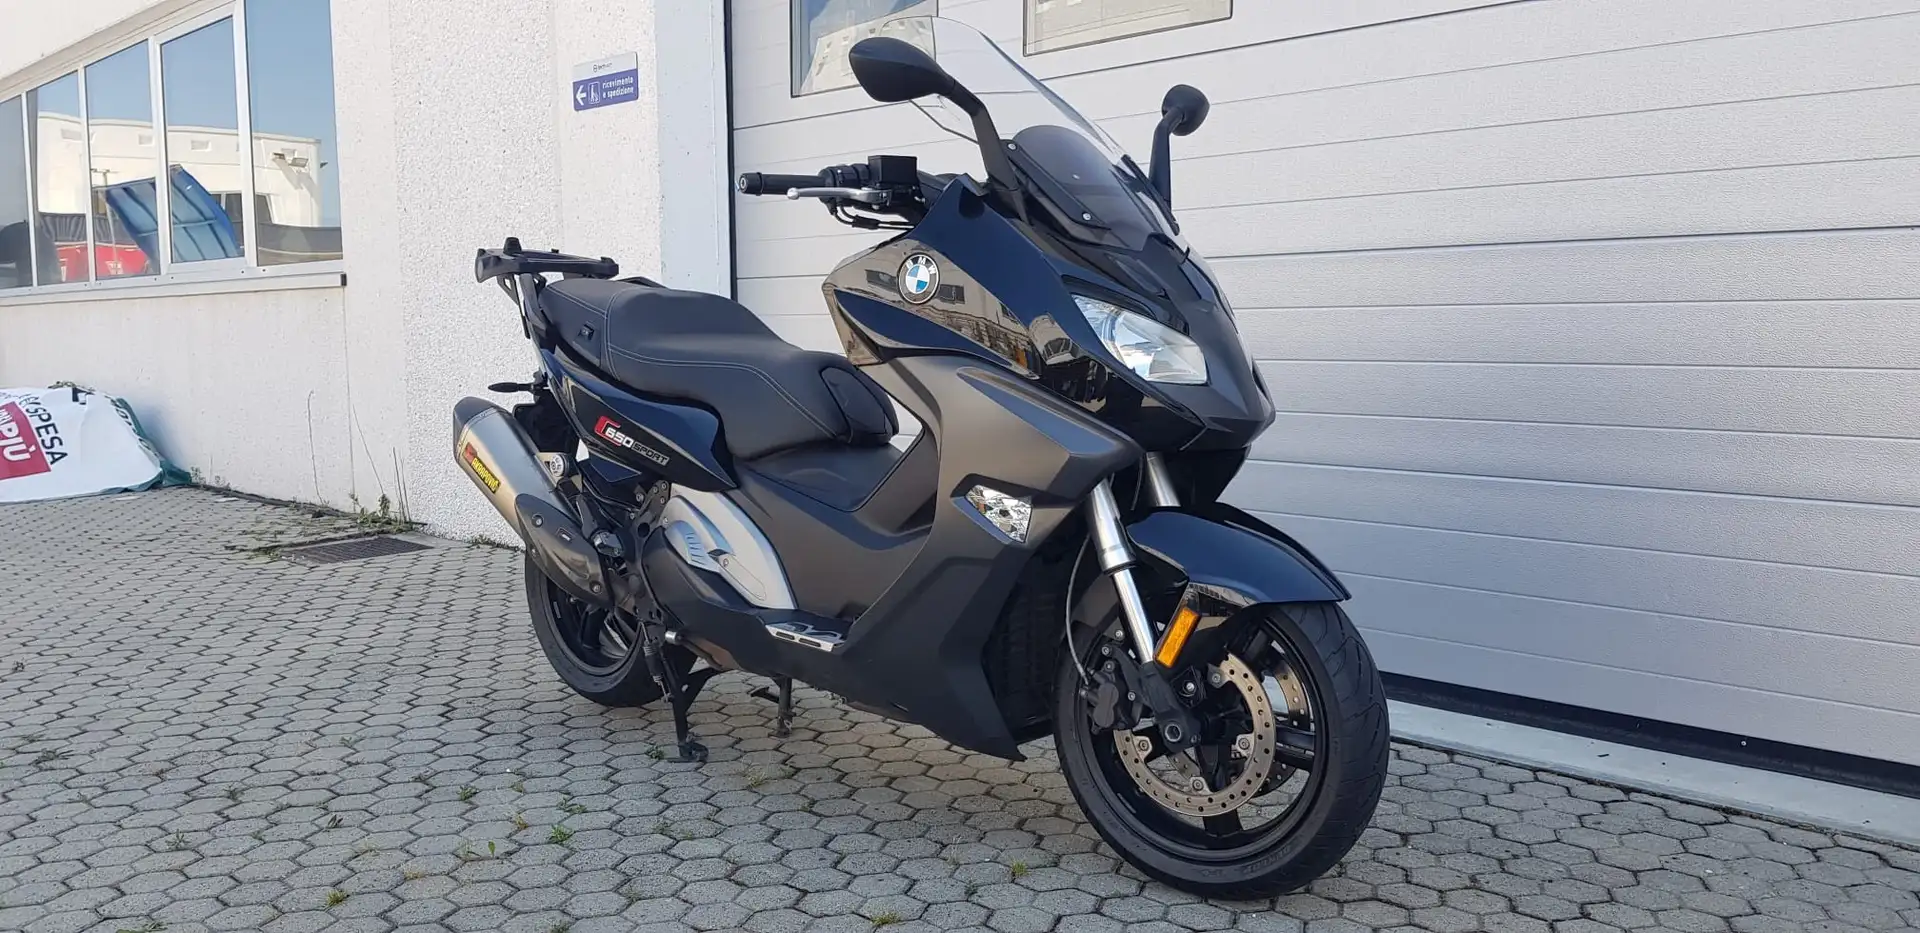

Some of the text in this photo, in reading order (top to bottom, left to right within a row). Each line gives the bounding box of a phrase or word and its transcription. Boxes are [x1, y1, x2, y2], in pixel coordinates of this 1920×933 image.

[602, 76, 634, 89] ricevimento
[607, 86, 634, 99] spedizione
[905, 256, 937, 275] BMW
[632, 442, 669, 466] SPORT
